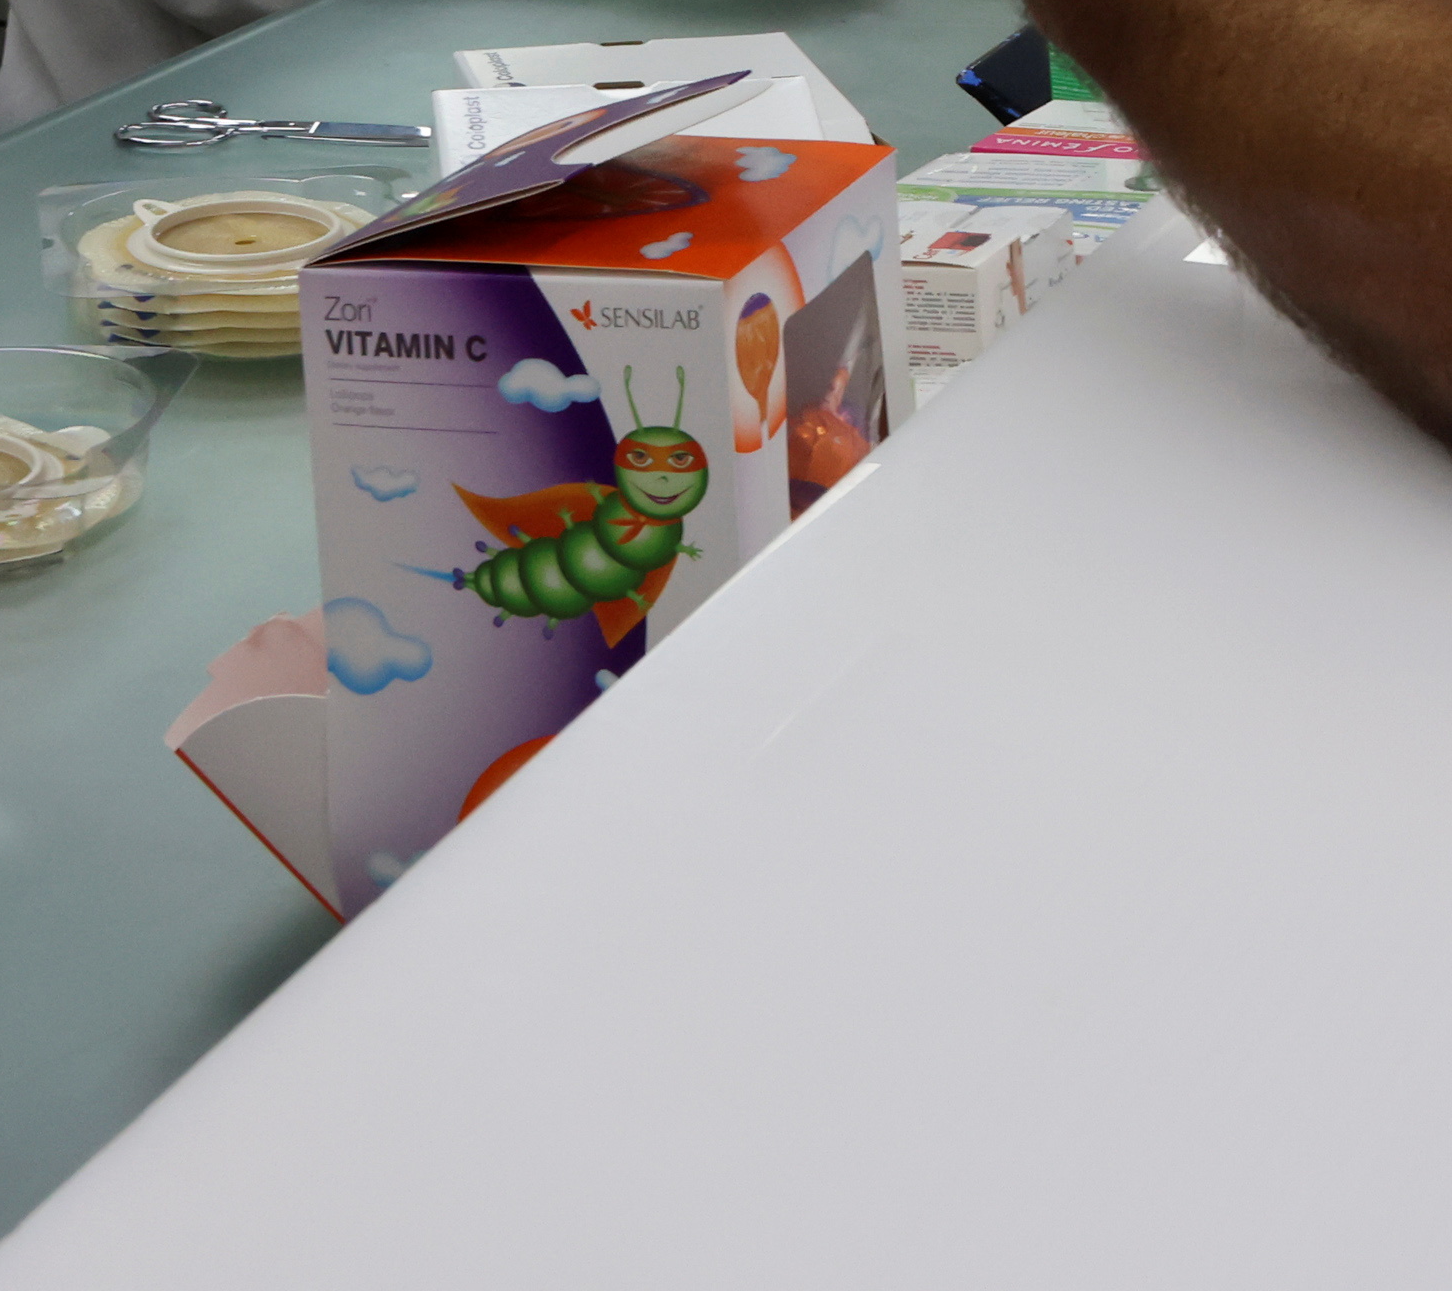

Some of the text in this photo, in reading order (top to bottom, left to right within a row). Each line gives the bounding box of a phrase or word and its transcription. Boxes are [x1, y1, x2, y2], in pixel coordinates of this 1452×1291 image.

[483, 51, 515, 82] Coloplast
[463, 95, 488, 152] Coloplast
[323, 295, 372, 323] Zori
[599, 306, 702, 331] SENSILAB
[324, 329, 489, 362] VITAMIN C
